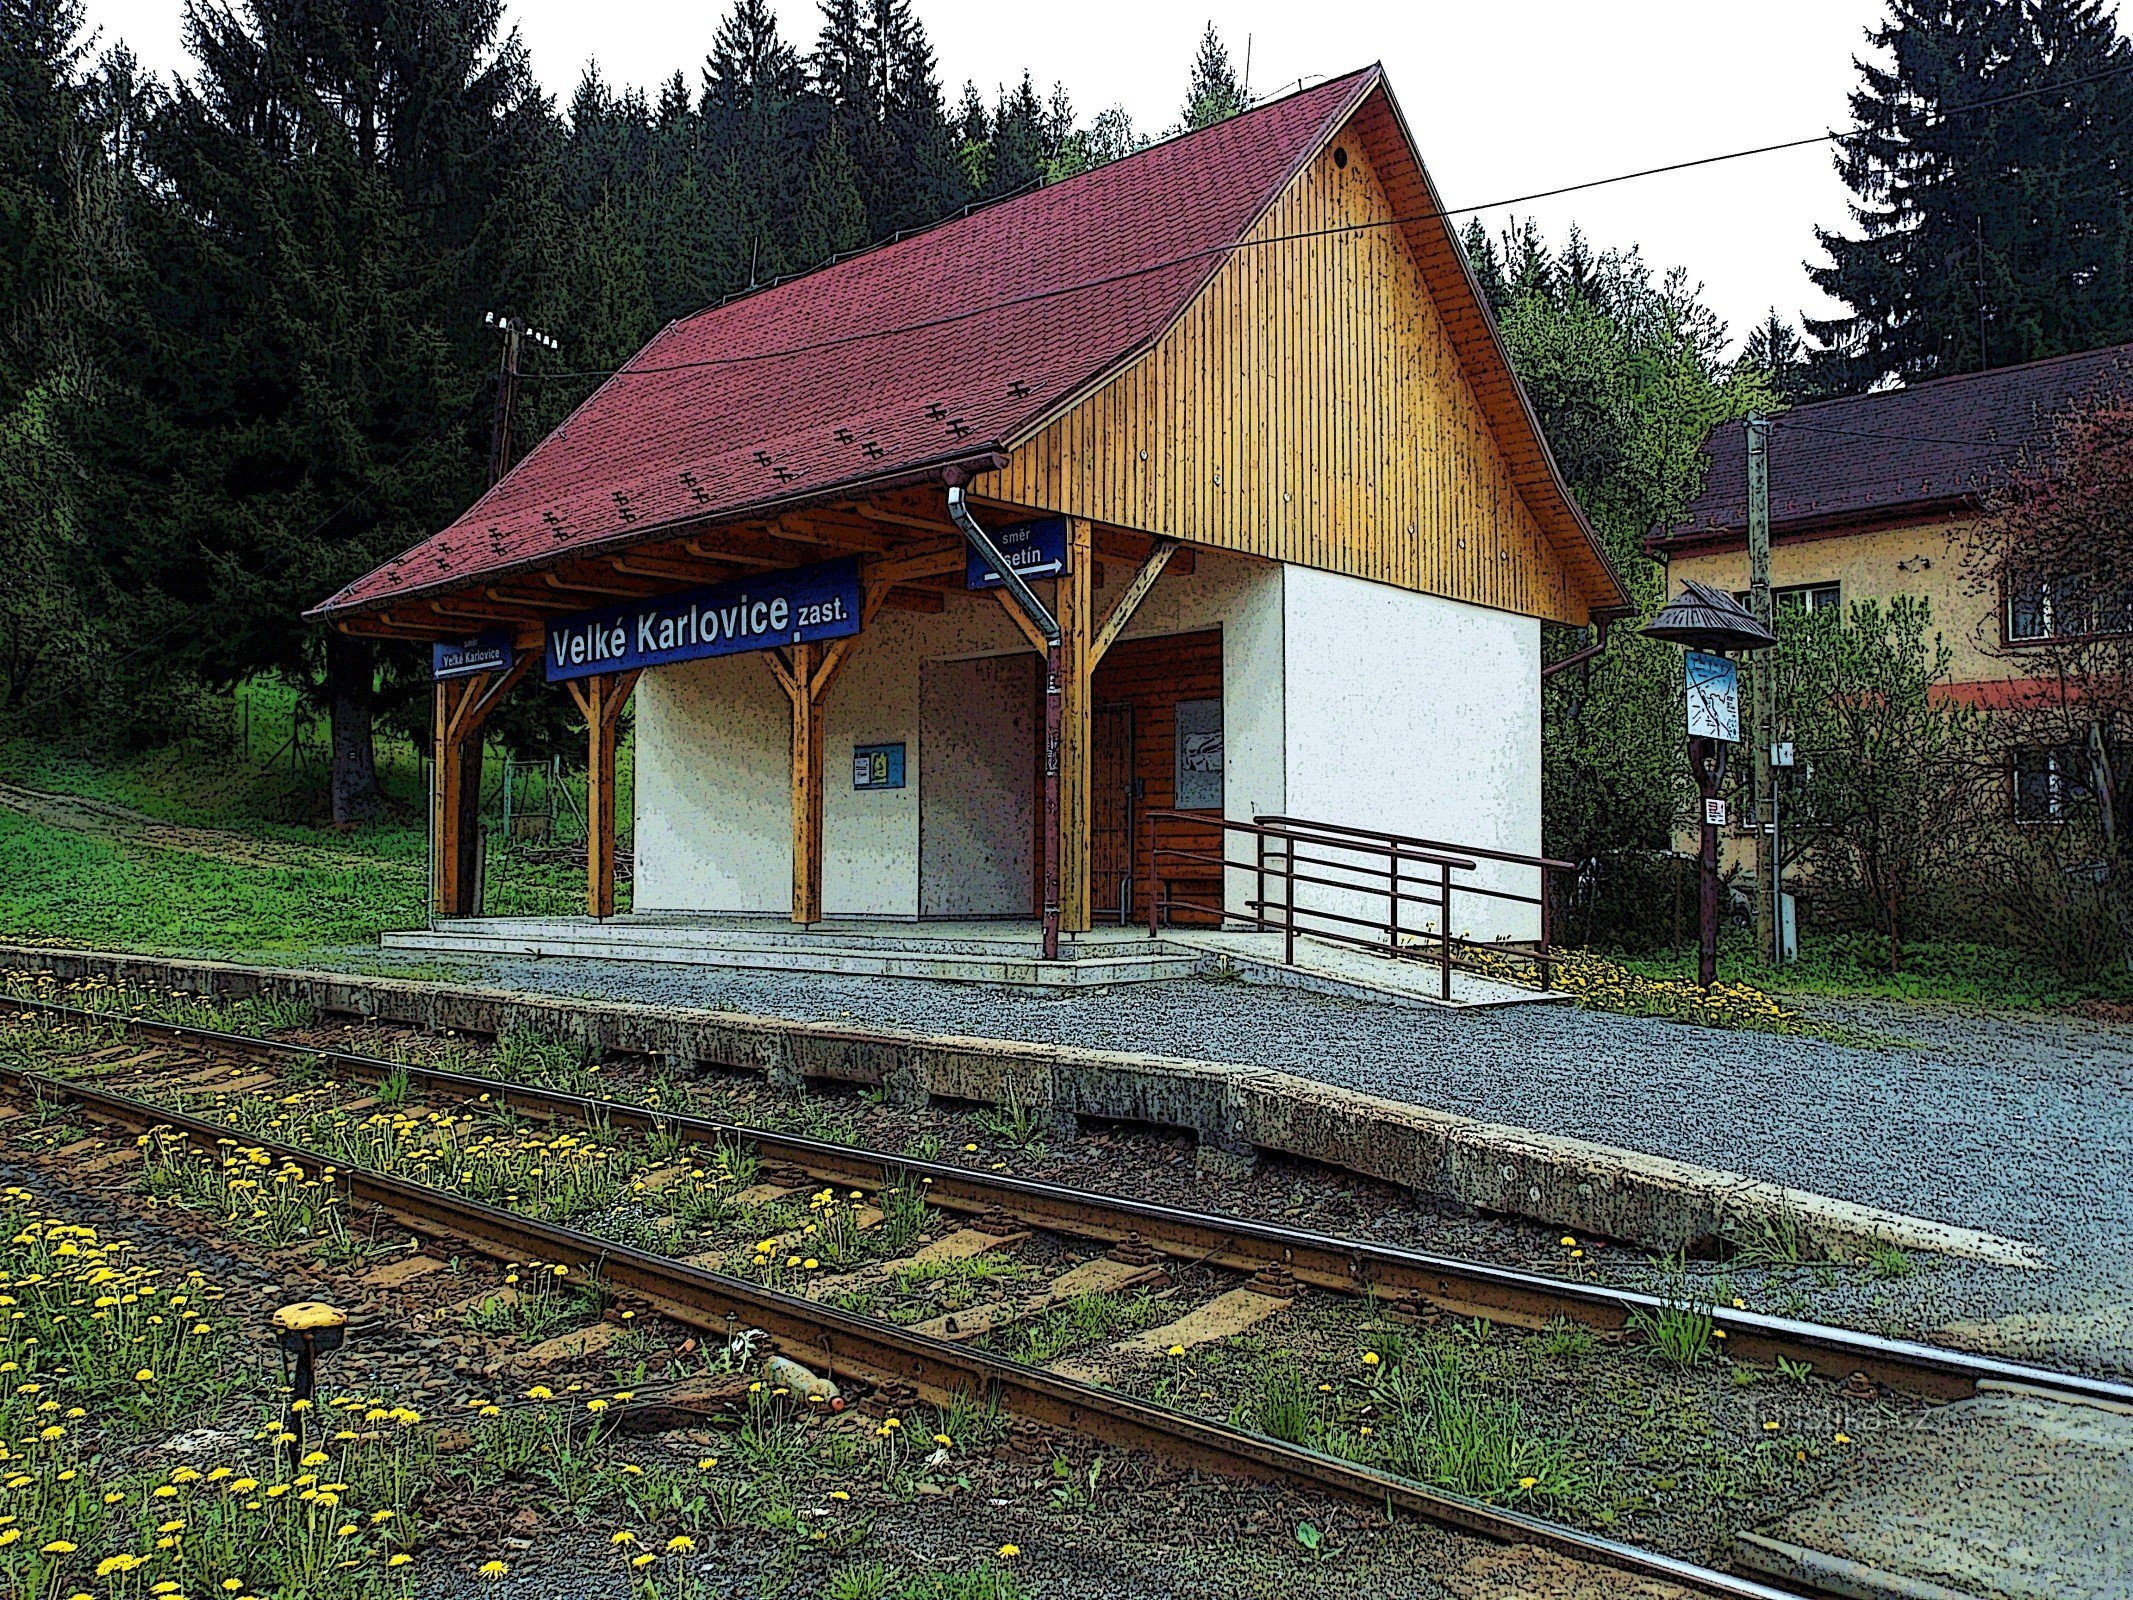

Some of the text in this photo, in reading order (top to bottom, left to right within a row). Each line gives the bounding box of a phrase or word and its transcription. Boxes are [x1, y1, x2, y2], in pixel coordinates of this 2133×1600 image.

[1002, 528, 1031, 545] směr
[1000, 546, 1041, 567] setín
[552, 594, 848, 667] Velké Karlovice zast.
[443, 648, 500, 667] Velké Karlovice
